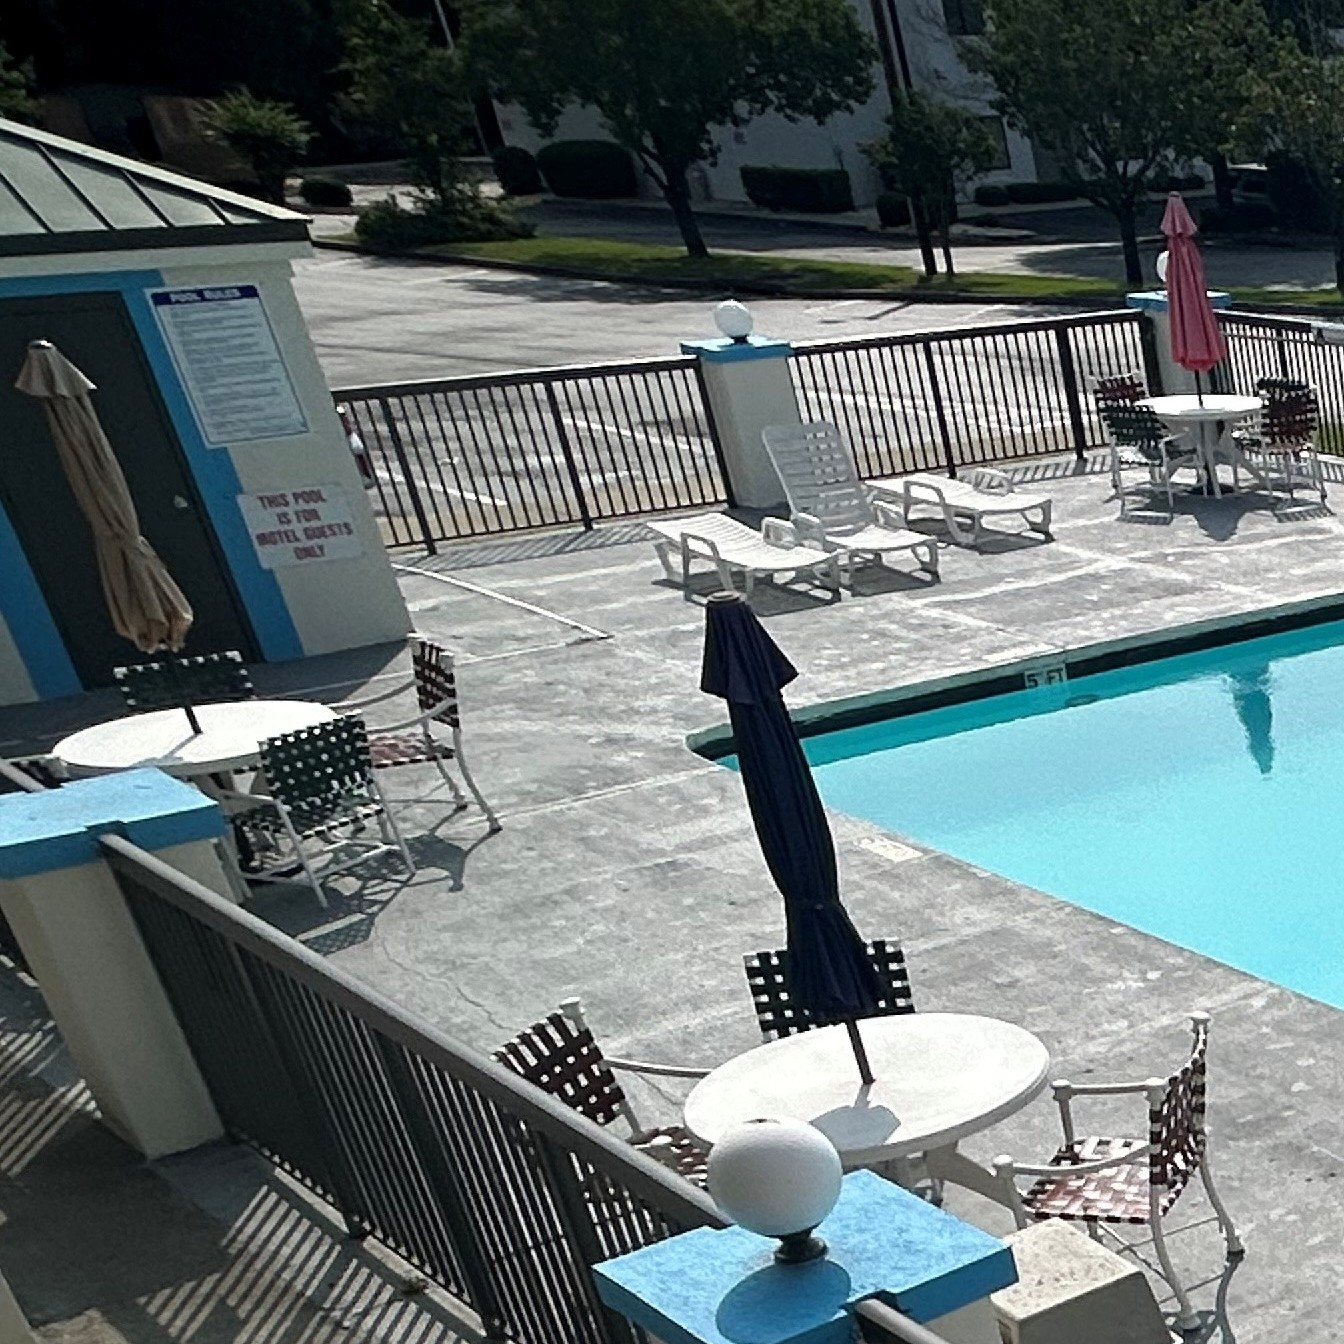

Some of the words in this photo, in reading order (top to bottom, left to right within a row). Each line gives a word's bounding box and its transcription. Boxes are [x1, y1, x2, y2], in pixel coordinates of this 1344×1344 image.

[169, 292, 200, 303] POOL
[203, 288, 241, 300] RULES
[257, 493, 290, 510] THIS
[293, 489, 326, 504] POOL
[277, 512, 291, 525] IS
[294, 508, 321, 523] FOR
[256, 529, 300, 546] MOTEL
[303, 522, 353, 540] GUESTS
[294, 545, 325, 560] ONLY
